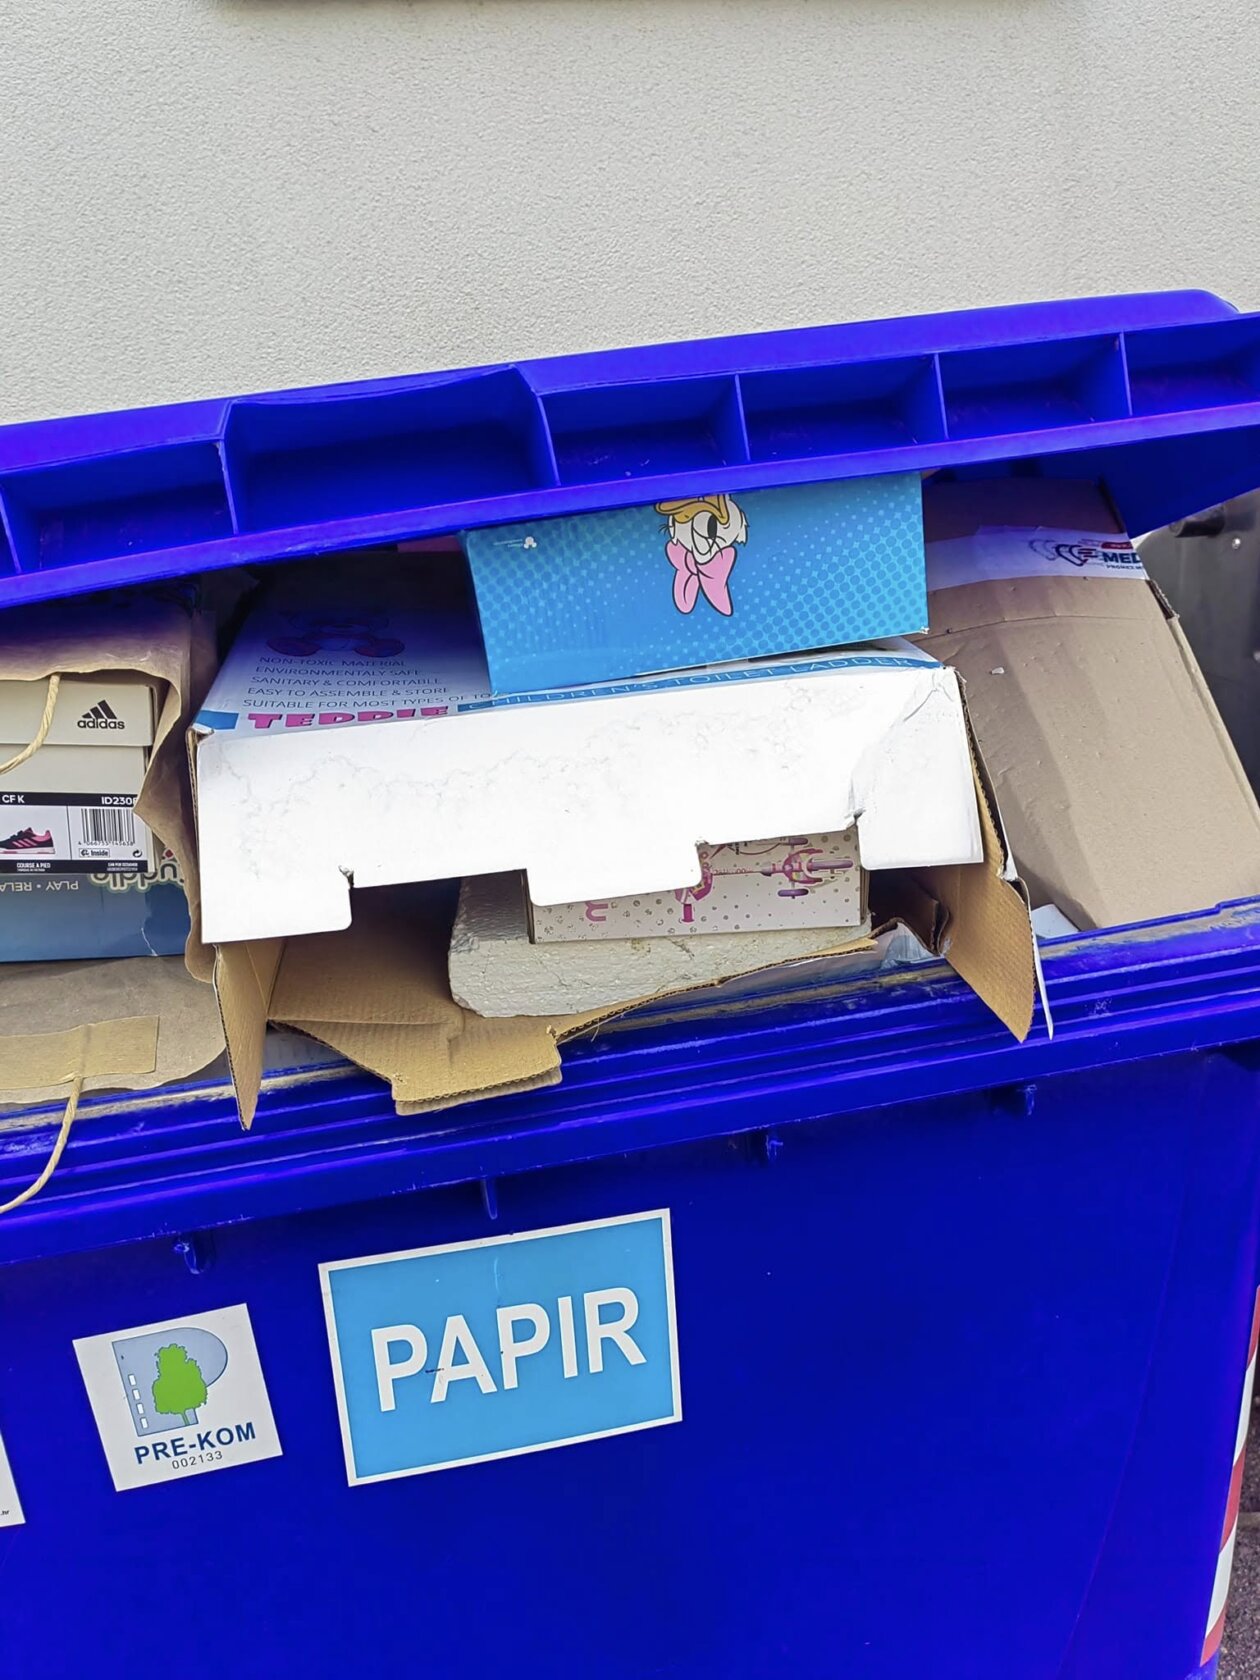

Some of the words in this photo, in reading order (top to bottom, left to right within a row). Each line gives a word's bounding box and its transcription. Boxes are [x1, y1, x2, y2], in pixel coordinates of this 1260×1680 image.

[342, 659, 405, 667] MATERIAL
[250, 676, 320, 686] SANITARY
[336, 678, 442, 687] COMFORTABLE
[469, 683, 658, 709] CHILDREN'S
[673, 668, 775, 686] TOILET
[790, 657, 912, 672] LADDER
[247, 687, 283, 696] EASY
[405, 687, 450, 695] STORE
[243, 700, 313, 709] SUITABLE
[403, 697, 443, 705] TYPES
[248, 706, 449, 729] TEDDIE
[77, 718, 126, 730] adidas
[2, 794, 16, 804] CF
[17, 794, 25, 804] K
[45, 880, 79, 891] PLAY
[371, 1287, 647, 1412] PAPIR
[134, 1421, 256, 1465] PRE-KOM
[172, 1450, 223, 1469] 002133
